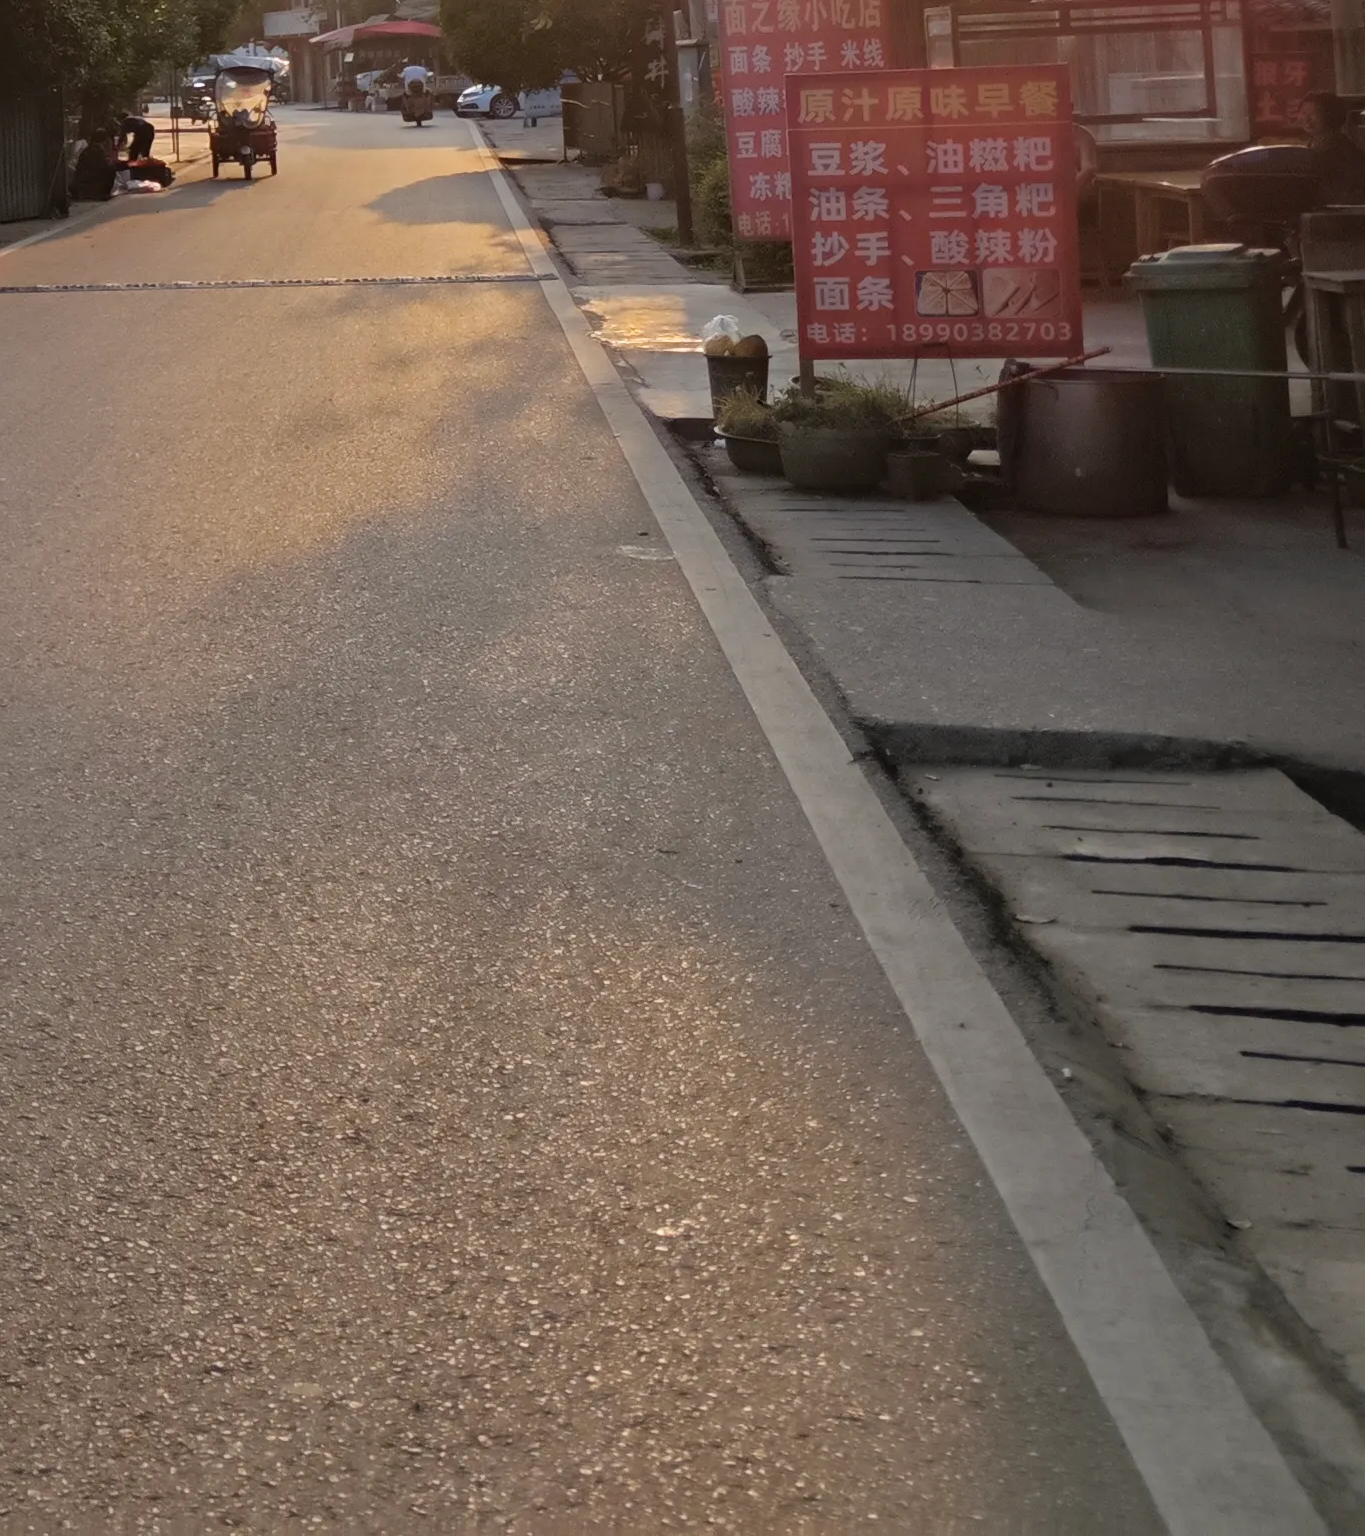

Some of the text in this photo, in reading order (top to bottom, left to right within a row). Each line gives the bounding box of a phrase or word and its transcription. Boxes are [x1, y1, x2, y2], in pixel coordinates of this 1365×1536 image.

[728, 38, 885, 75] 面条 抄手 米线
[730, 86, 786, 117] 酸辣
[797, 80, 1060, 124] 原汁原味早餐
[735, 129, 789, 159] 豆腐
[813, 275, 895, 312] 面条
